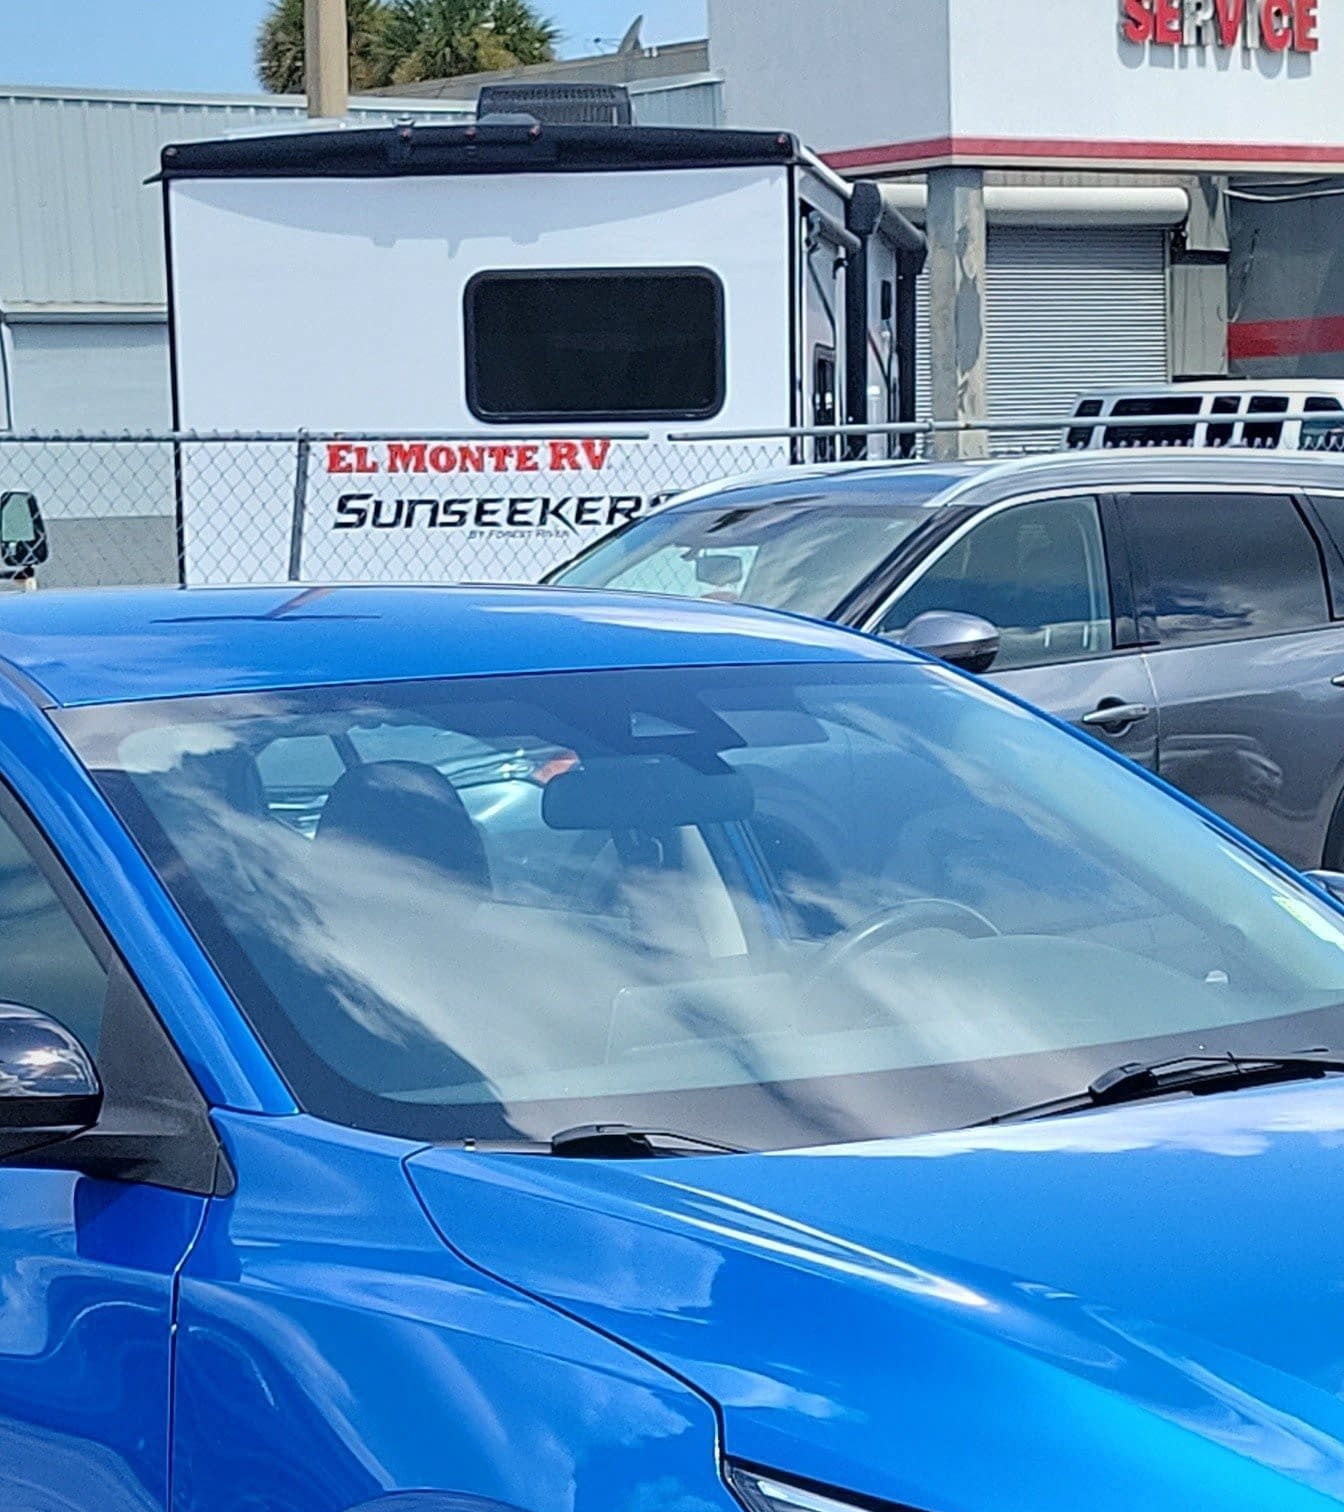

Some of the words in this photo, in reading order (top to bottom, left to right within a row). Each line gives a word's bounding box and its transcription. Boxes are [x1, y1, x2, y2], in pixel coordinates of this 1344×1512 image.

[1121, 0, 1319, 51] SERVICE
[326, 443, 378, 474] EL
[386, 443, 540, 474] MONTE
[548, 439, 611, 472] RV
